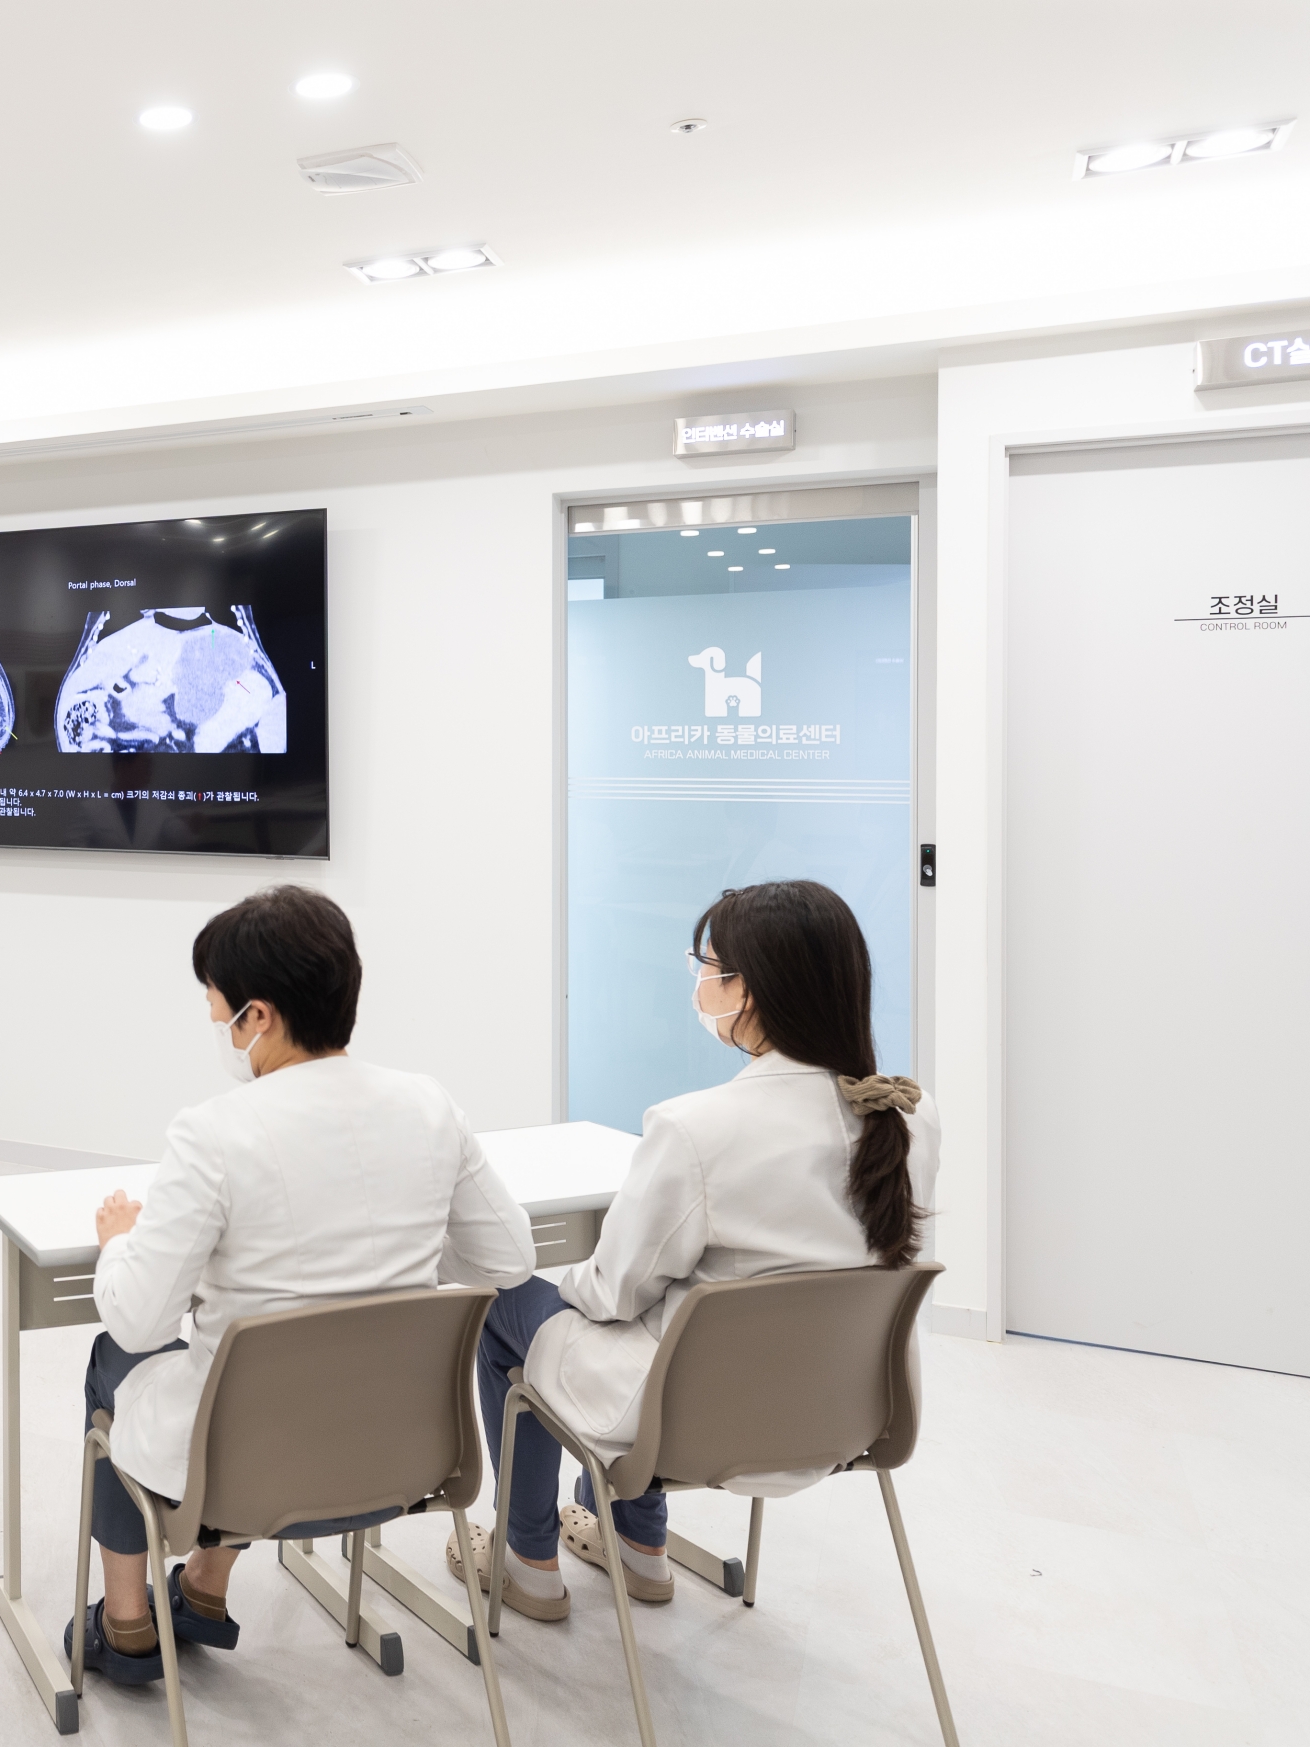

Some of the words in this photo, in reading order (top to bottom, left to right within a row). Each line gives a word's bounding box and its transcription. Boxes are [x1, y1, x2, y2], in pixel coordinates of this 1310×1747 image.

[68, 581, 88, 589] Portal
[90, 581, 111, 590] phase,
[114, 578, 136, 587] Dorsal
[1209, 594, 1278, 615] 조정실
[1200, 622, 1250, 631] CONTROL
[1254, 621, 1287, 630] ROOM
[311, 660, 316, 670] L
[631, 725, 710, 744] 아프리카
[715, 724, 841, 745] 동물의료센터
[644, 750, 683, 759] AFRICA
[686, 750, 728, 759] ANIMAL
[730, 750, 781, 759] MEDICAL
[783, 750, 830, 759] CENTER
[0, 788, 7, 796] 내
[9, 788, 16, 797] 약
[65, 790, 76, 799] (W
[111, 791, 124, 800] cm)
[126, 790, 149, 799] 크기의
[216, 791, 259, 801] 관찰됩니다.
[0, 807, 36, 816] 관찰됩니다.
